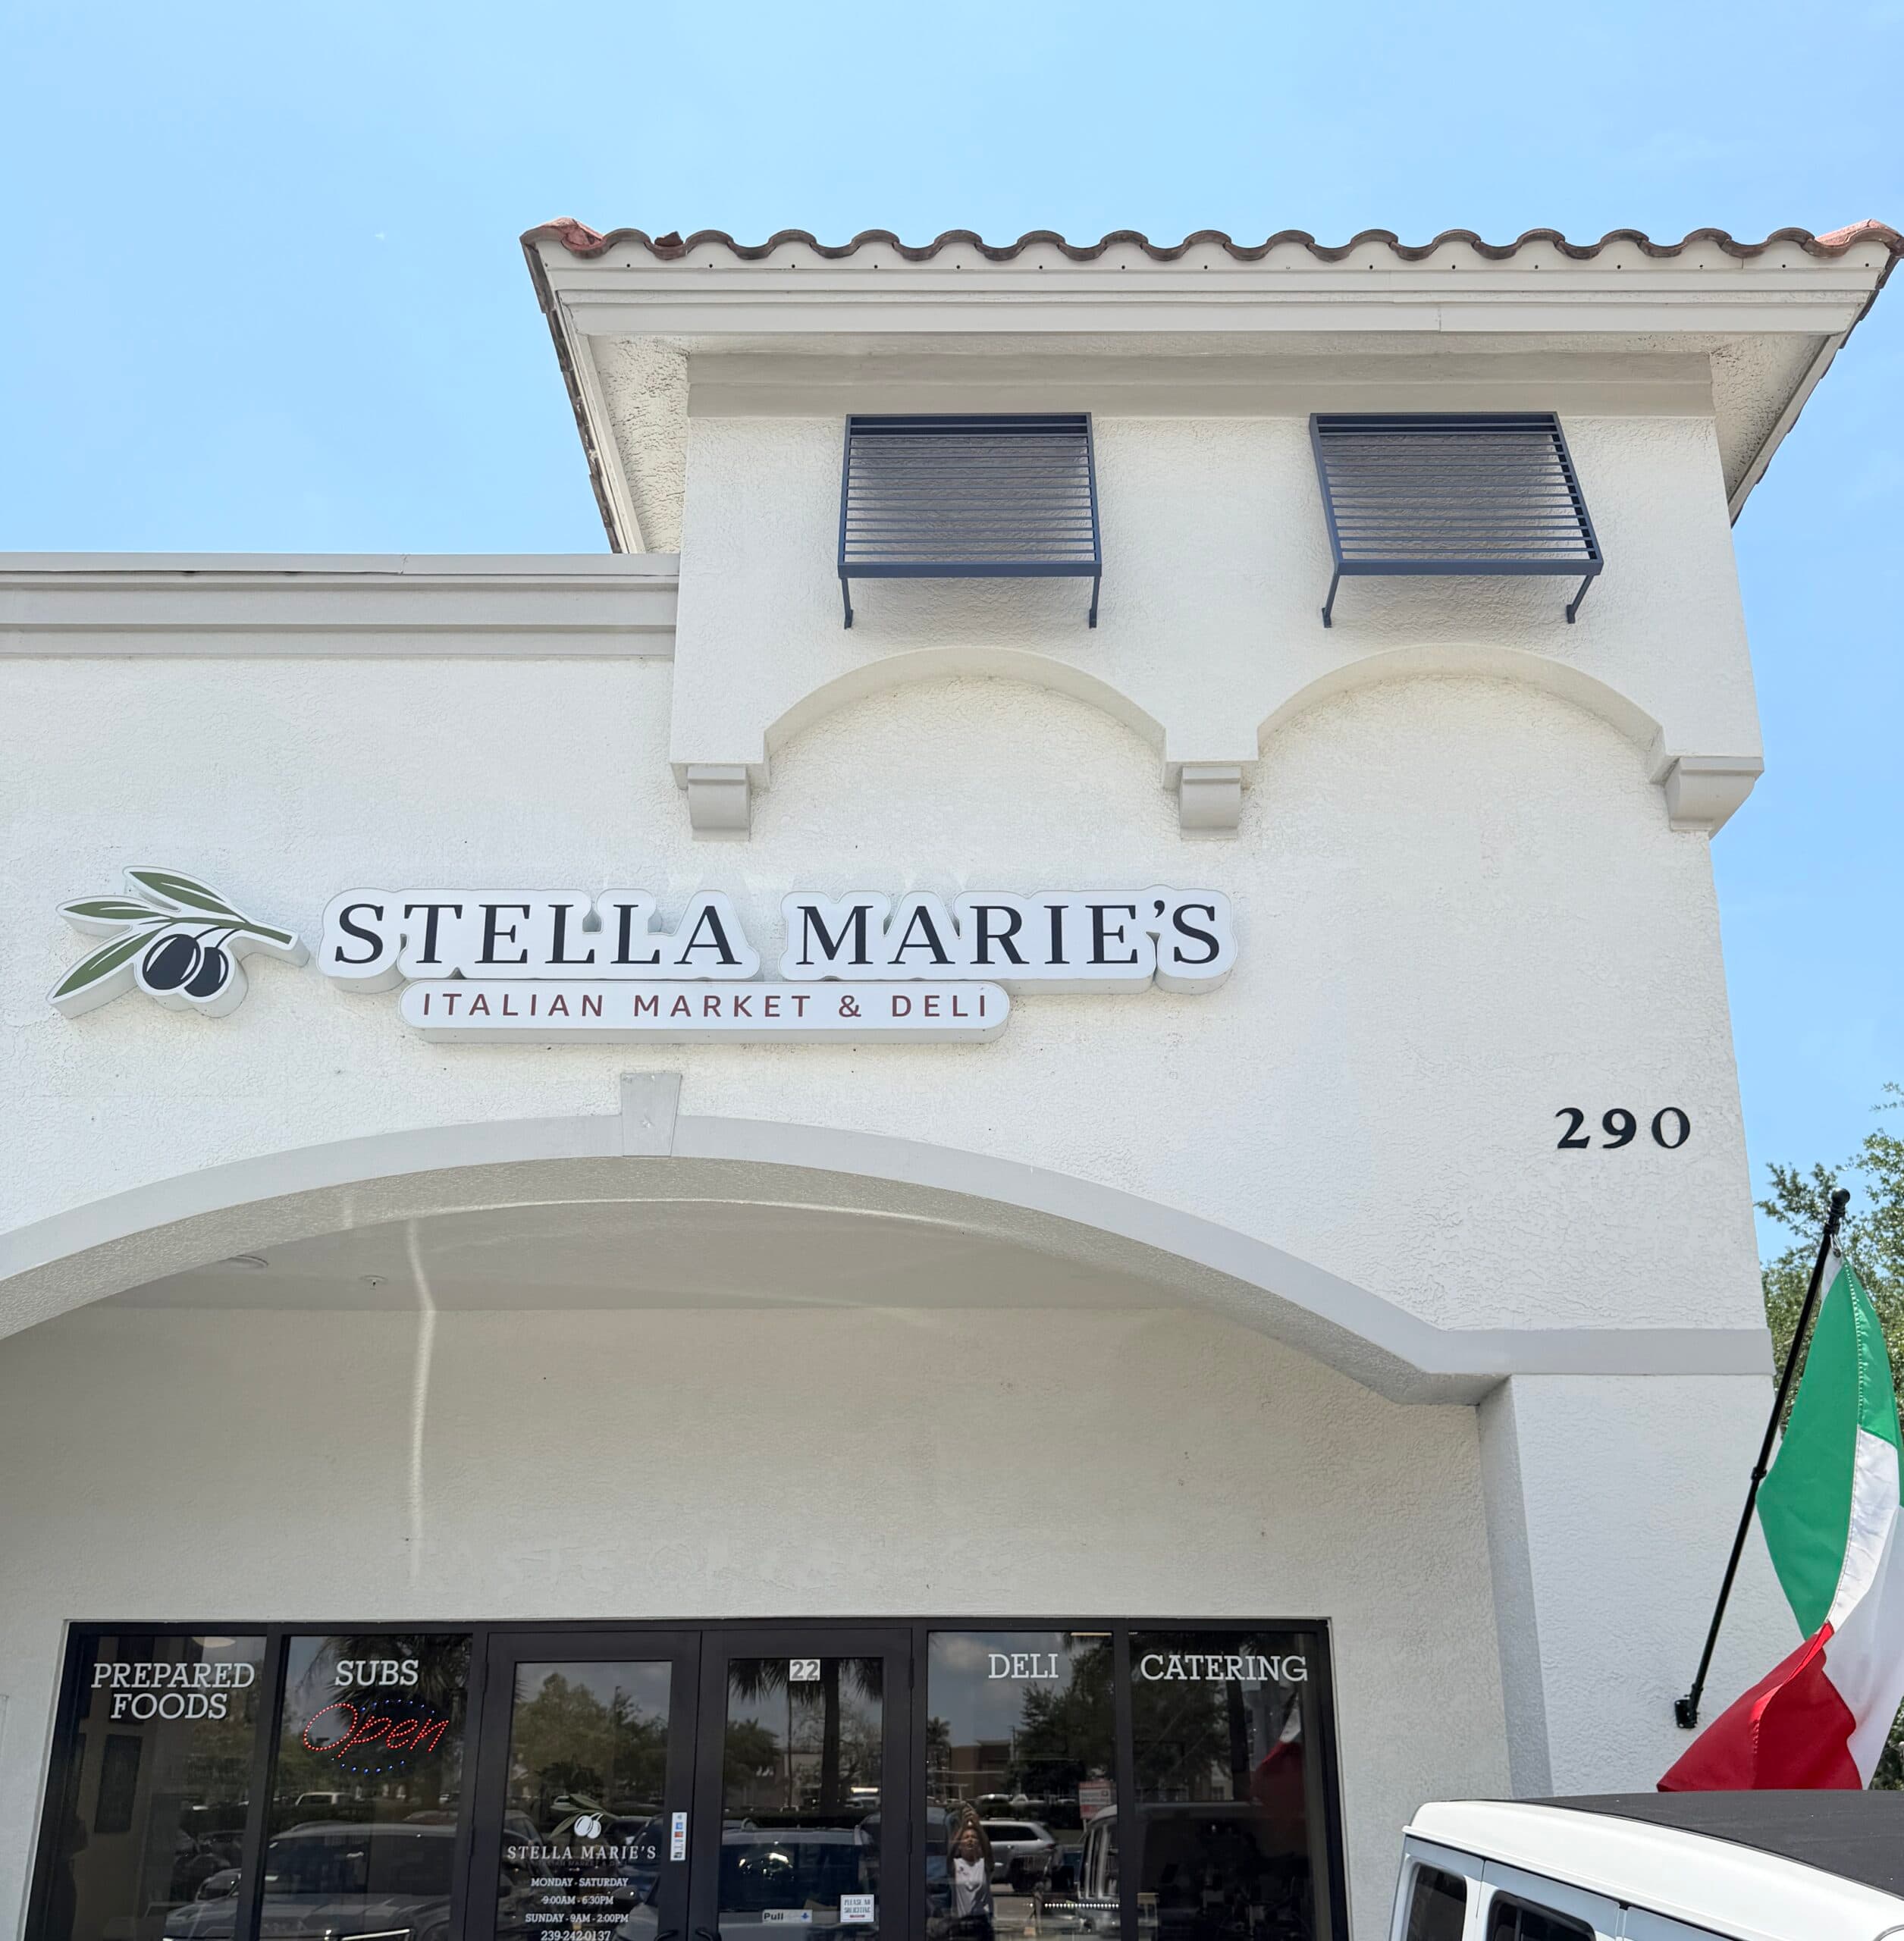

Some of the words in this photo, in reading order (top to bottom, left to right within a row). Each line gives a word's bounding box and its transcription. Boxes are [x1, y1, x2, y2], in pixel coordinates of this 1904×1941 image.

[334, 903, 743, 965] STELLA
[795, 899, 1220, 966] MARIE'S
[423, 992, 604, 1018] ITALIAN
[633, 994, 811, 1018] MARKET
[839, 995, 862, 1018] &
[892, 995, 986, 1018] DELI
[1555, 1107, 1690, 1149] 290
[91, 1663, 256, 1689] PREPARED
[335, 1659, 419, 1687] SUBS
[792, 1660, 819, 1679] 22
[988, 1653, 1059, 1679] DELI
[1140, 1654, 1308, 1682] CATERING
[111, 1693, 228, 1720] FOODS
[303, 1702, 450, 1759] Open
[507, 1845, 574, 1860] STELLA
[581, 1845, 657, 1860] MARIE'S
[531, 1877, 574, 1887] MONDAY
[579, 1877, 629, 1887] SATURDAY
[542, 1896, 576, 1905] 9:00AM
[582, 1896, 613, 1905] 6:30PM
[525, 1913, 565, 1923] SUNDAY
[570, 1913, 591, 1923] 9AM
[597, 1913, 629, 1923] 2:00PM
[764, 1912, 783, 1921] Pull
[541, 1930, 611, 1941] 239-242-0137
